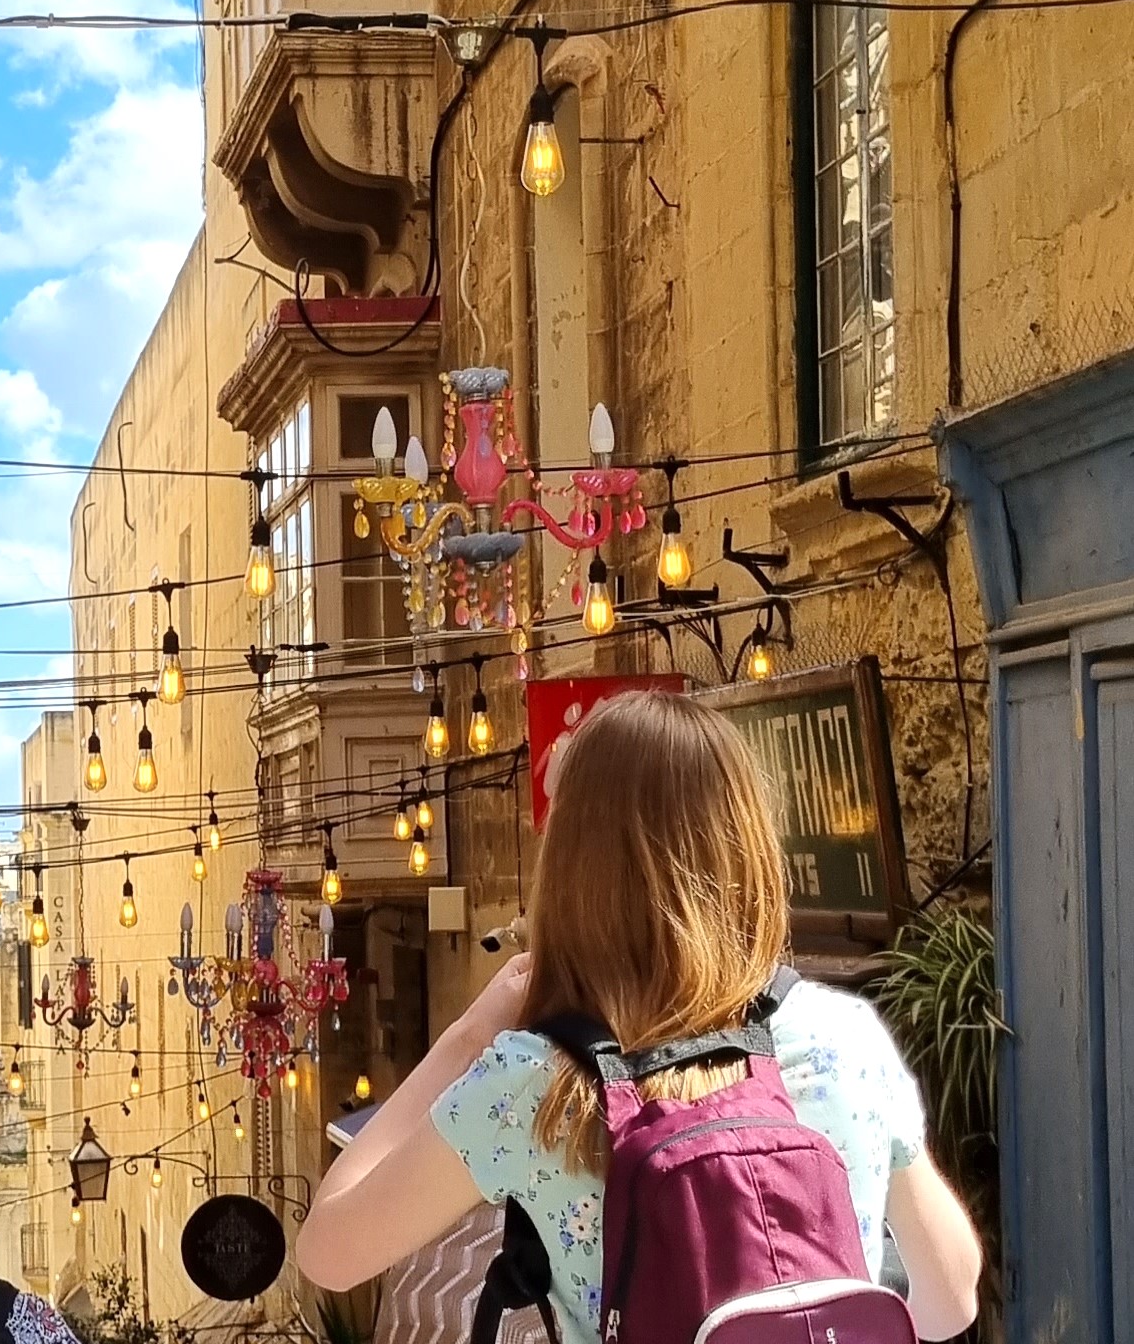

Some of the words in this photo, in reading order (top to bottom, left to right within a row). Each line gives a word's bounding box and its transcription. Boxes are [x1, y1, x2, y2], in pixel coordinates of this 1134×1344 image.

[739, 705, 865, 837] UFRAGO
[792, 853, 821, 896] TS
[53, 896, 64, 953] CASA
